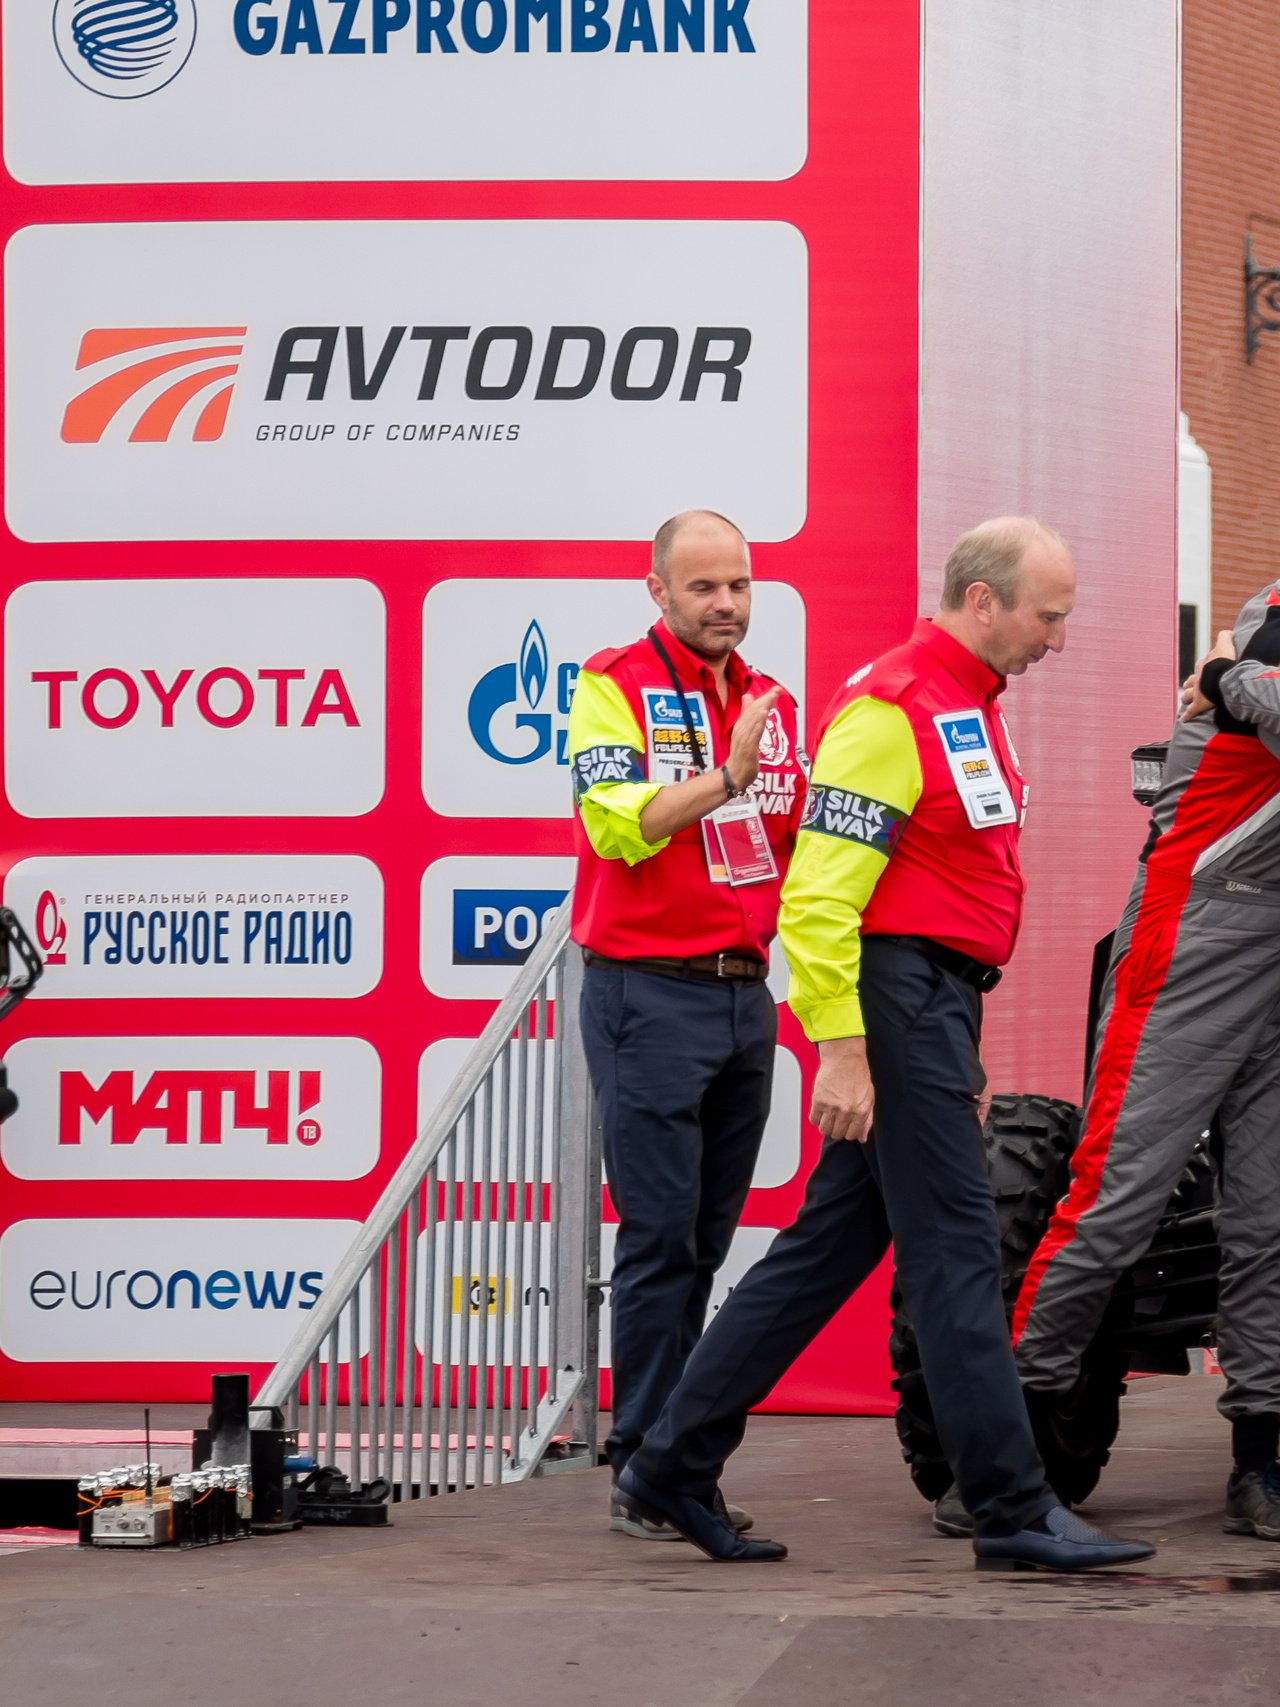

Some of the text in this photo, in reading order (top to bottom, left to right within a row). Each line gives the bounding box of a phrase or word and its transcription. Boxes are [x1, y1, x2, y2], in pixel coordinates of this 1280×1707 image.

[232, 0, 756, 56] GAZPROMBANK
[264, 326, 752, 402] AVTODOR
[255, 424, 521, 442] GROUP OF COMPANIES
[31, 666, 361, 729] TOYOTA
[577, 747, 633, 772] SILK
[654, 743, 707, 755] FBLIFE.CM
[580, 762, 632, 787] WAY
[752, 772, 797, 794] SILK
[756, 794, 796, 815] WAY
[826, 790, 887, 826] SILK
[824, 810, 882, 842] WAY
[85, 891, 349, 906] ГЕНЕРАЛЬНЫЙ РАДИОПАРТНЕР
[83, 910, 352, 965] РУССКОЕ РАДИО
[30, 1269, 324, 1311] euronews
